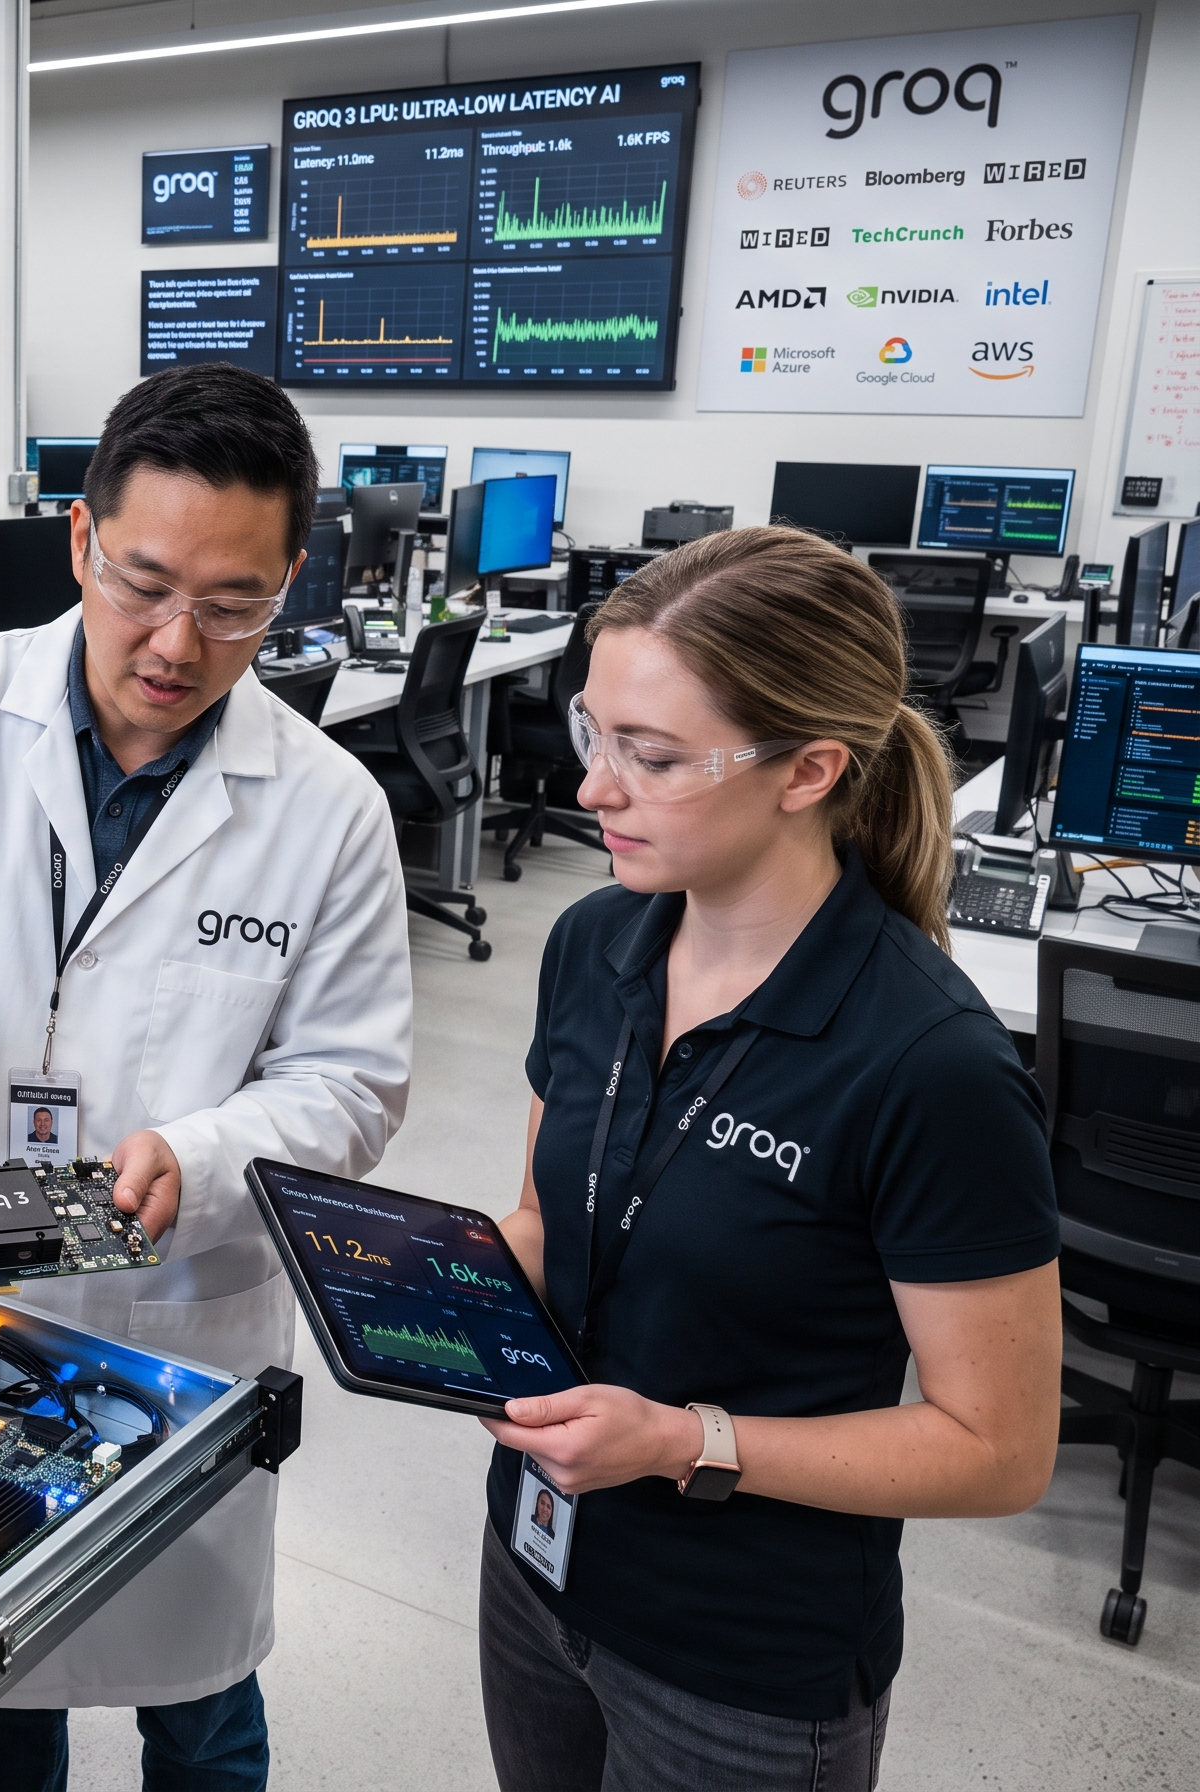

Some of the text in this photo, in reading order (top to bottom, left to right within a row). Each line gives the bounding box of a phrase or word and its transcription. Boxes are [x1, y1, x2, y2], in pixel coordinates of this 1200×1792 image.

[661, 75, 686, 89] groq
[293, 84, 621, 130] GROQ 3 LPU: ULTRA-LOW LATENCY AI
[645, 131, 670, 145] FPS
[865, 168, 965, 187] Bloomberg
[984, 158, 1087, 184] WIRED
[773, 175, 847, 191] REUTERS
[740, 227, 830, 249] WIRED
[852, 225, 964, 243] TechCrunch
[985, 218, 1073, 242] Forbes
[735, 288, 802, 309] AMD
[985, 280, 1050, 306] intel
[773, 347, 835, 359] Microsoft
[971, 341, 1034, 361] aws
[772, 362, 810, 373] Azure
[856, 372, 935, 385] Google Cloud
[13, 1191, 30, 1205] 3
[485, 1276, 512, 1292] FPS
[502, 1346, 552, 1372] groq
